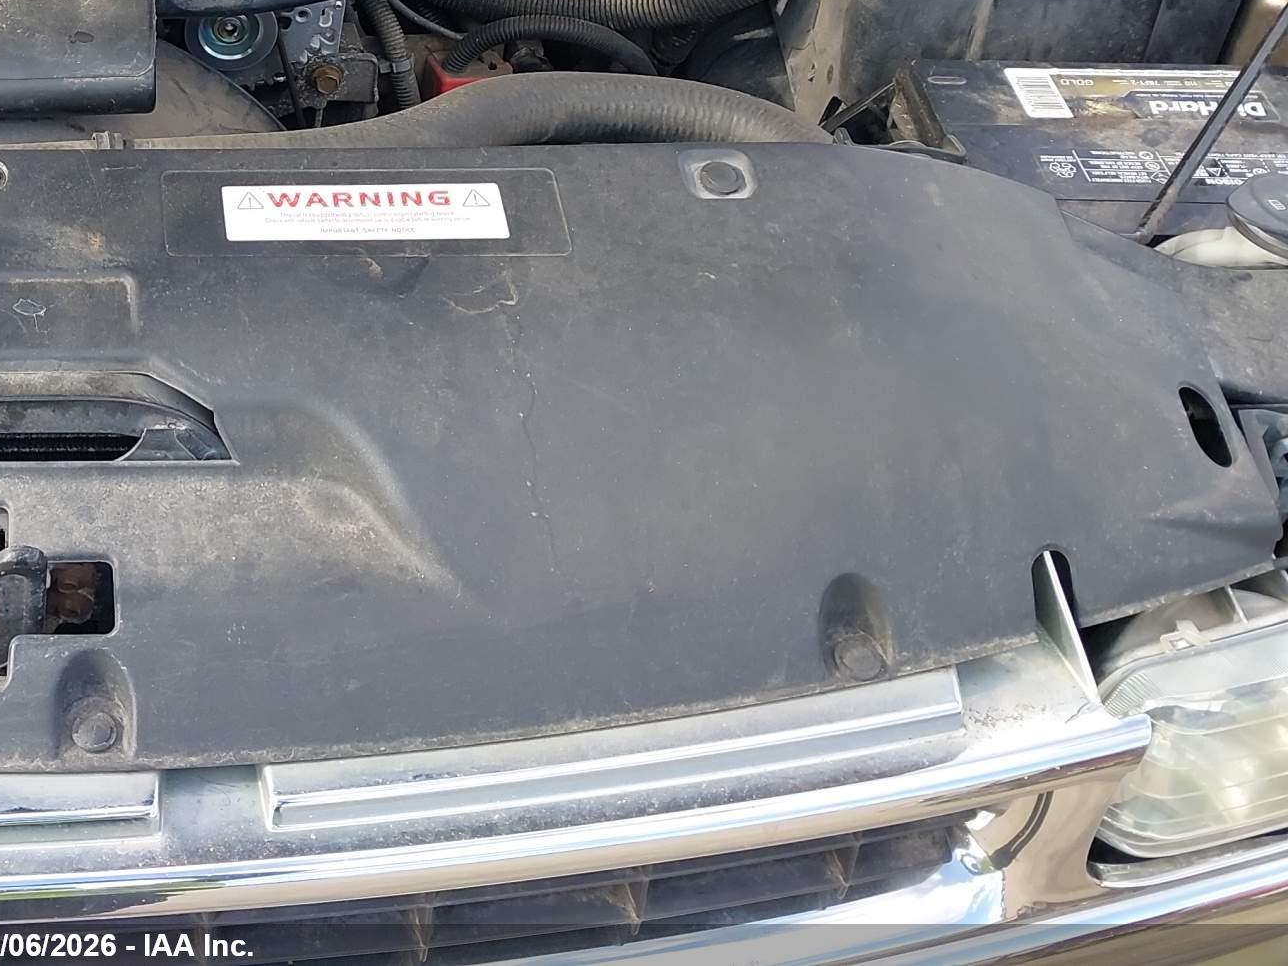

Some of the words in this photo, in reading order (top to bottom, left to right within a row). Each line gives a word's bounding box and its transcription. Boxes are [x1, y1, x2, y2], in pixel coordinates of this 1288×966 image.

[1060, 77, 1094, 86] GOLD
[1148, 101, 1268, 117] DiHard
[267, 189, 452, 209] WARNING
